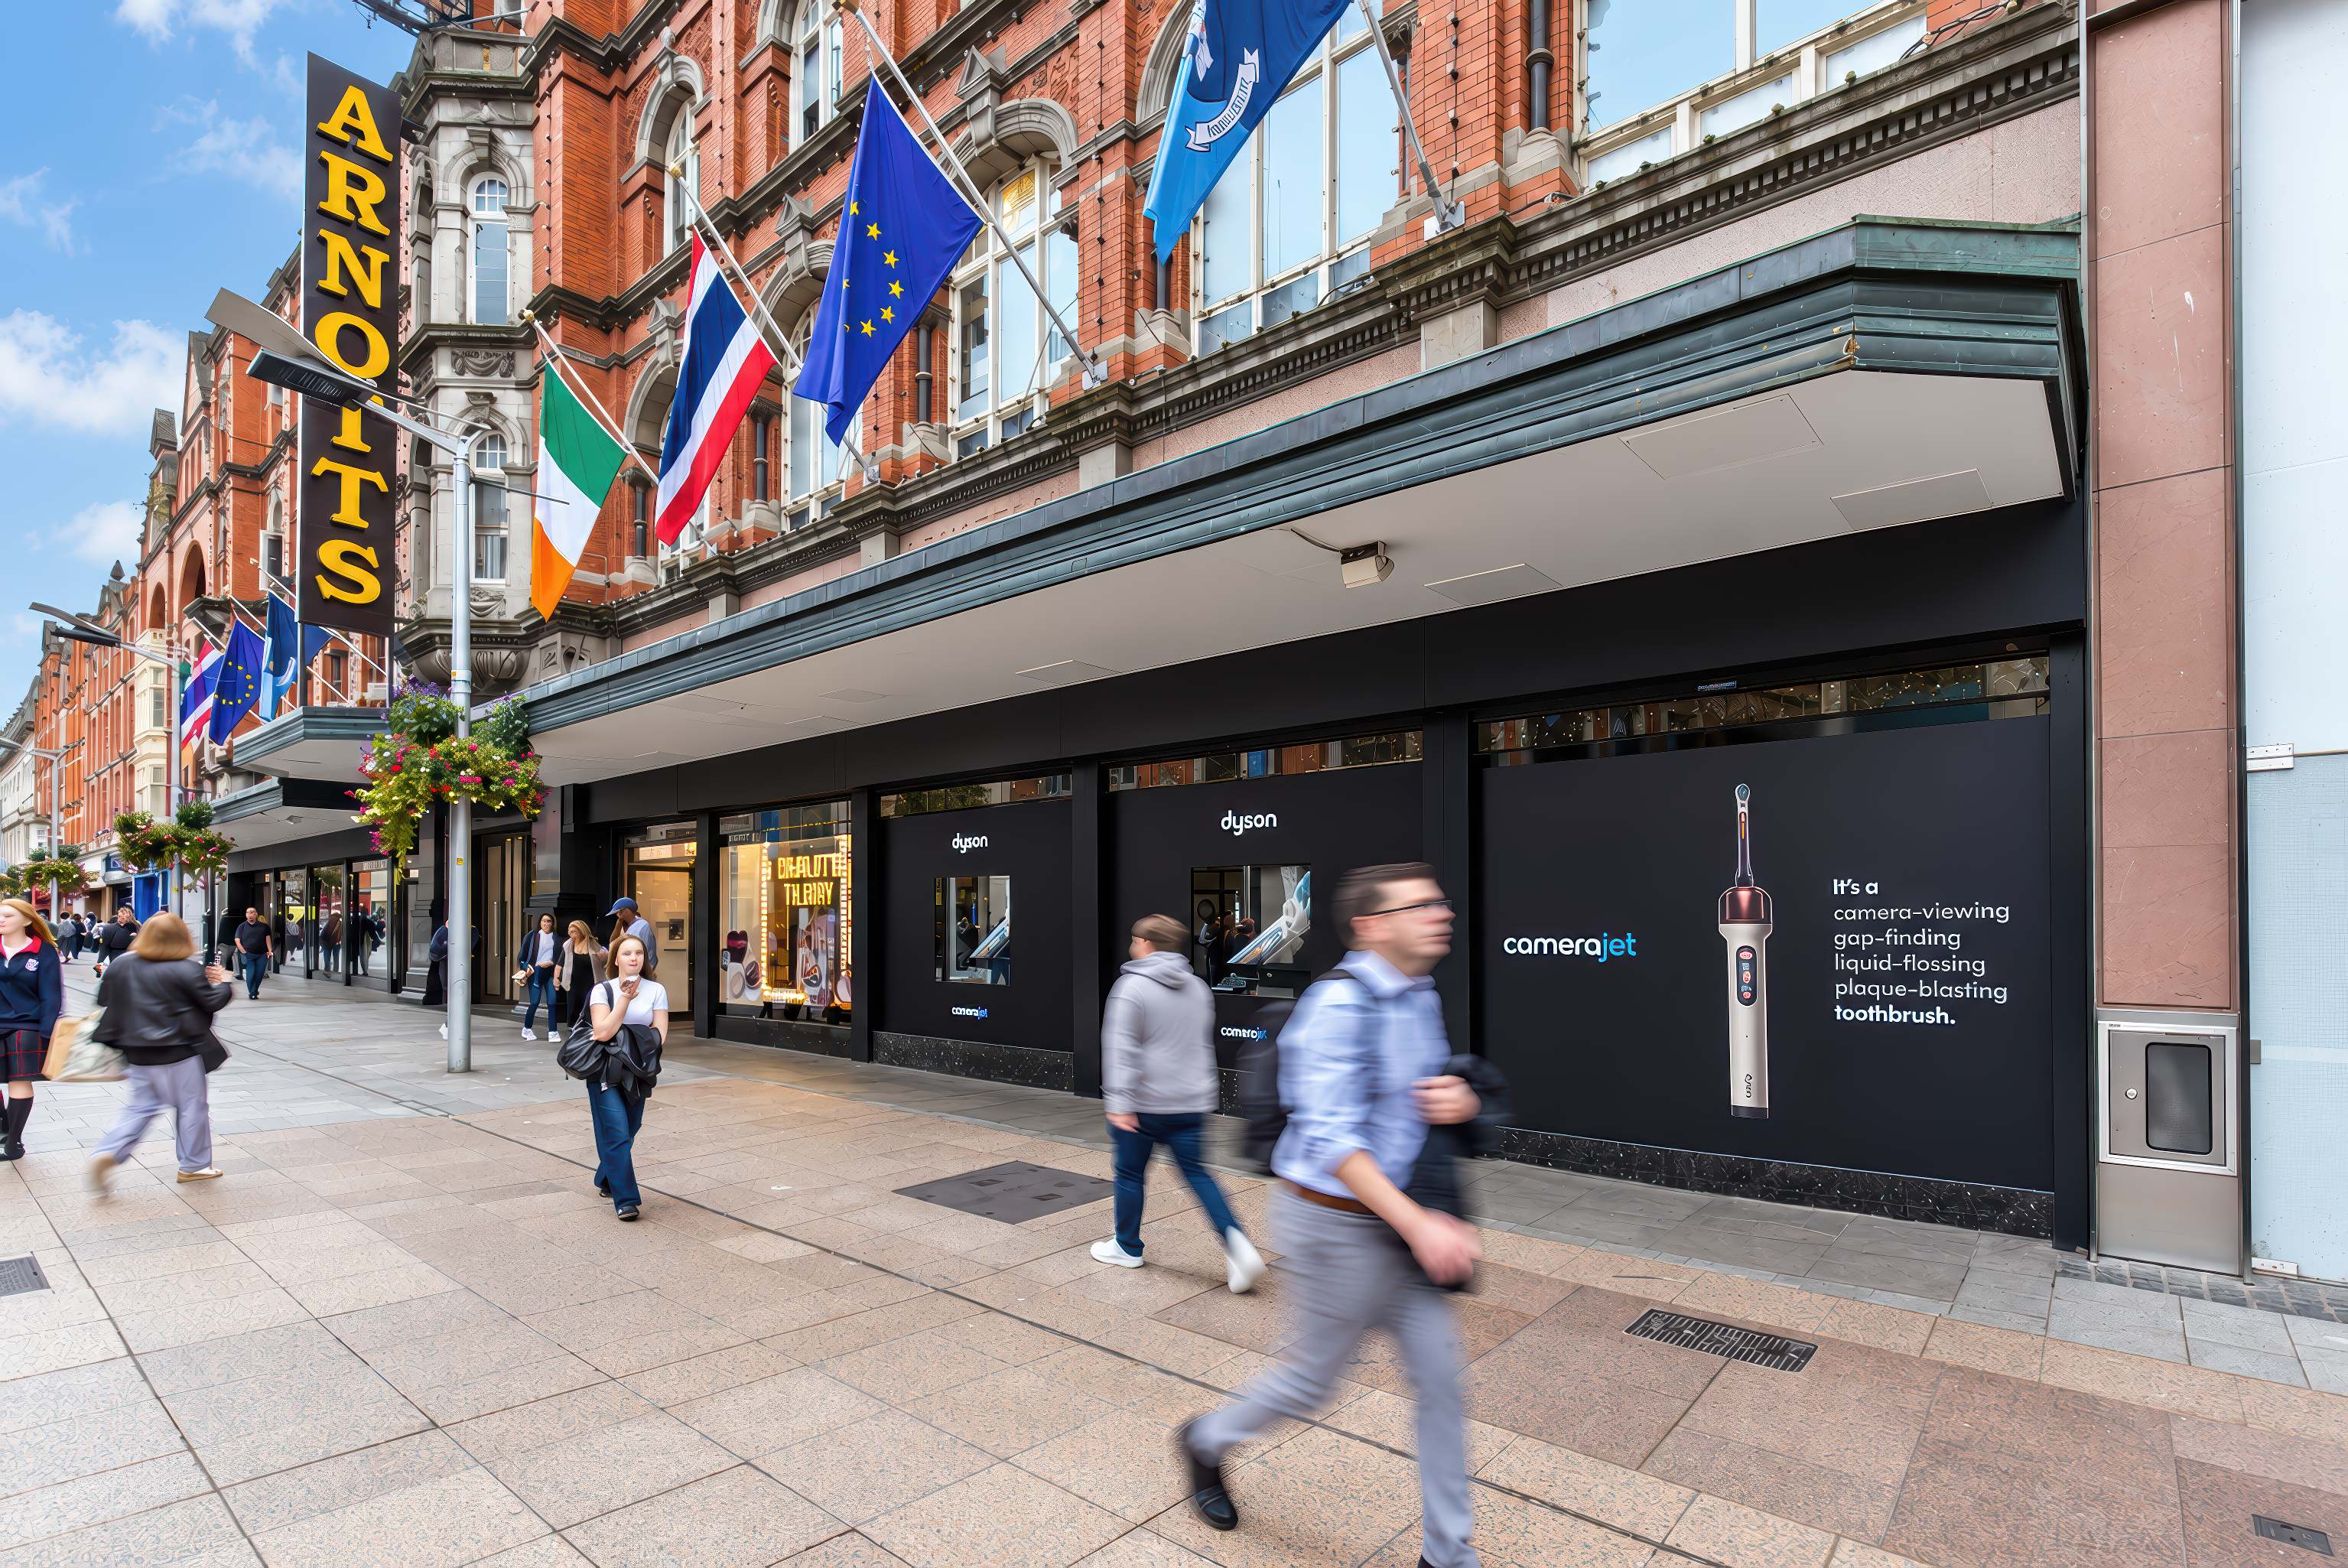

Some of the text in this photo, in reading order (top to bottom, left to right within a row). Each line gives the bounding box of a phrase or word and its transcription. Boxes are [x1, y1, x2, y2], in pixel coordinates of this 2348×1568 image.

[1221, 810, 1276, 836] dyson
[952, 832, 988, 854] dyson
[1833, 879, 1879, 895] It's a
[1833, 901, 2010, 924] camera-viewing
[1504, 932, 1637, 963] camerajet
[1833, 928, 1961, 951] gap-finding
[1835, 953, 1985, 978] liquid-flossing
[1835, 978, 2008, 1004] plaque-blasting
[1834, 1004, 1956, 1025] toothbrush.
